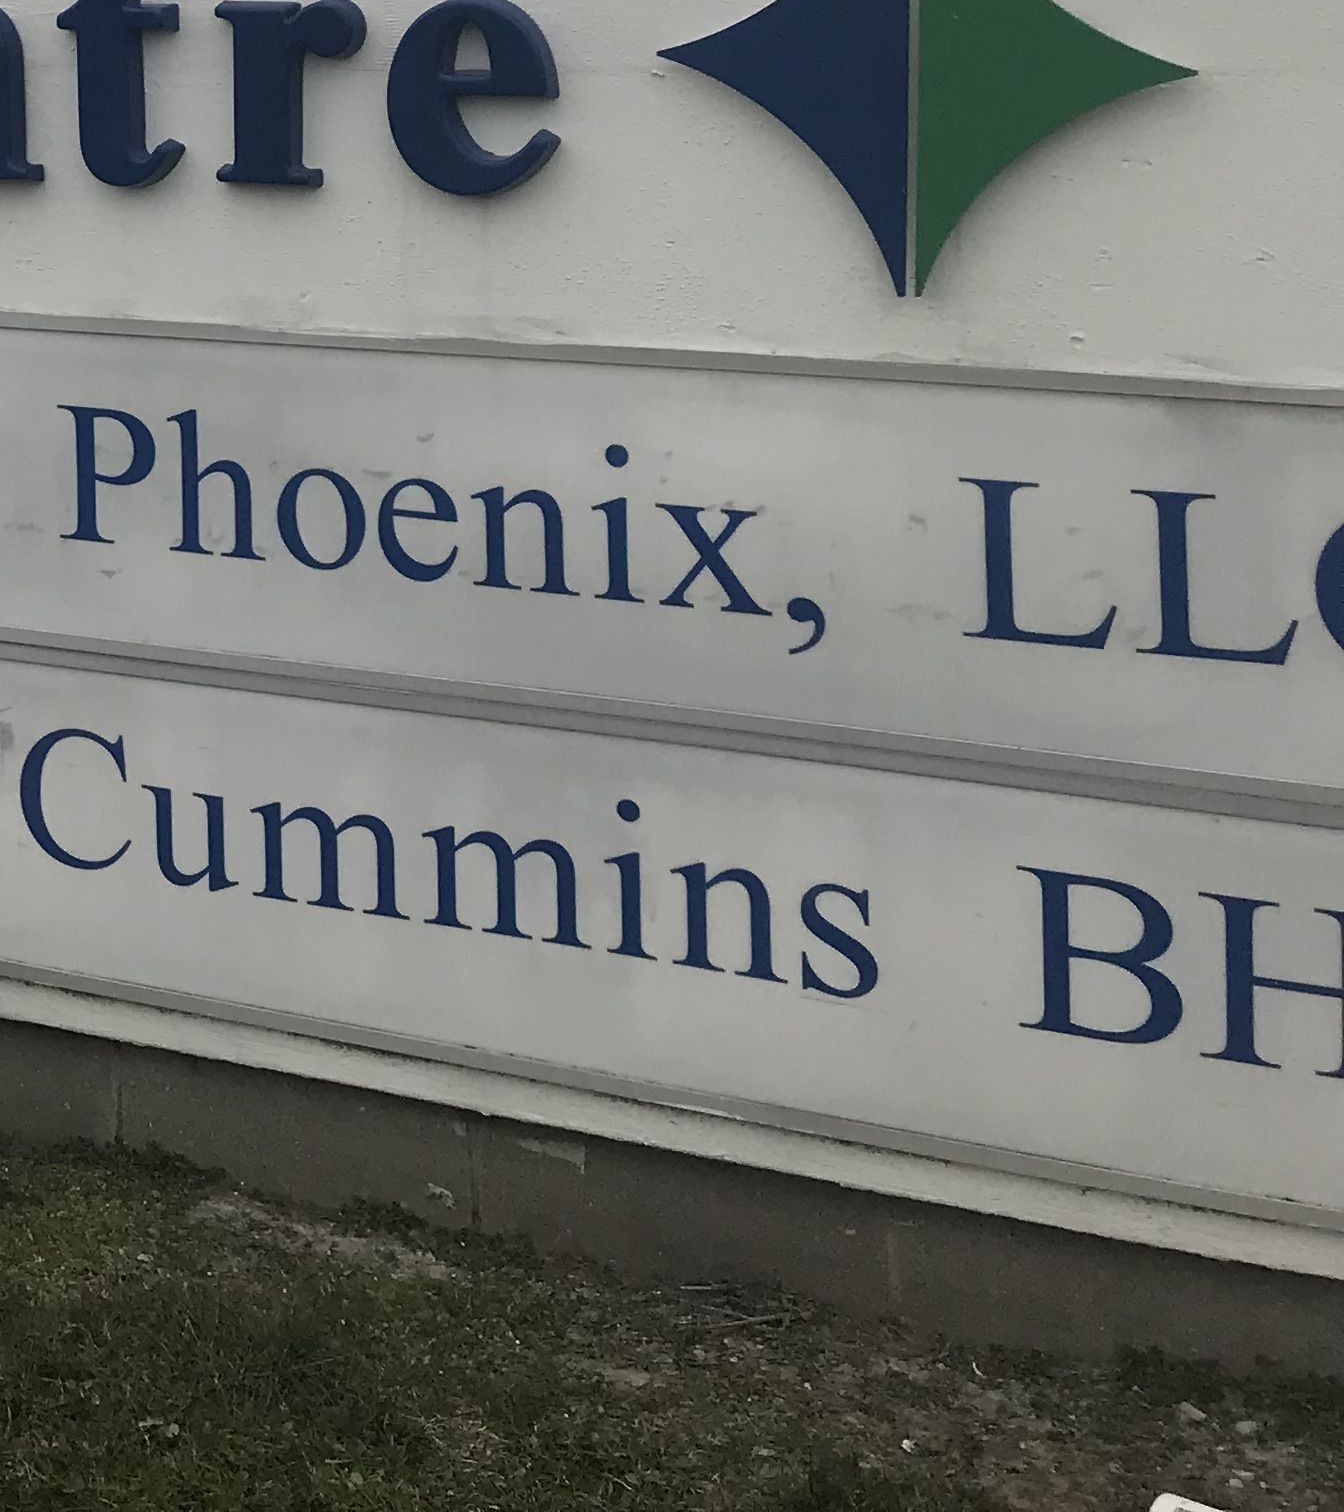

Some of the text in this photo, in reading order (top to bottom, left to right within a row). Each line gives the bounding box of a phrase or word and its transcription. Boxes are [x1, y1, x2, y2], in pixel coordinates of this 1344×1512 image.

[56, 404, 1344, 665] Phoenix, LL
[18, 728, 880, 1000] Cummins
